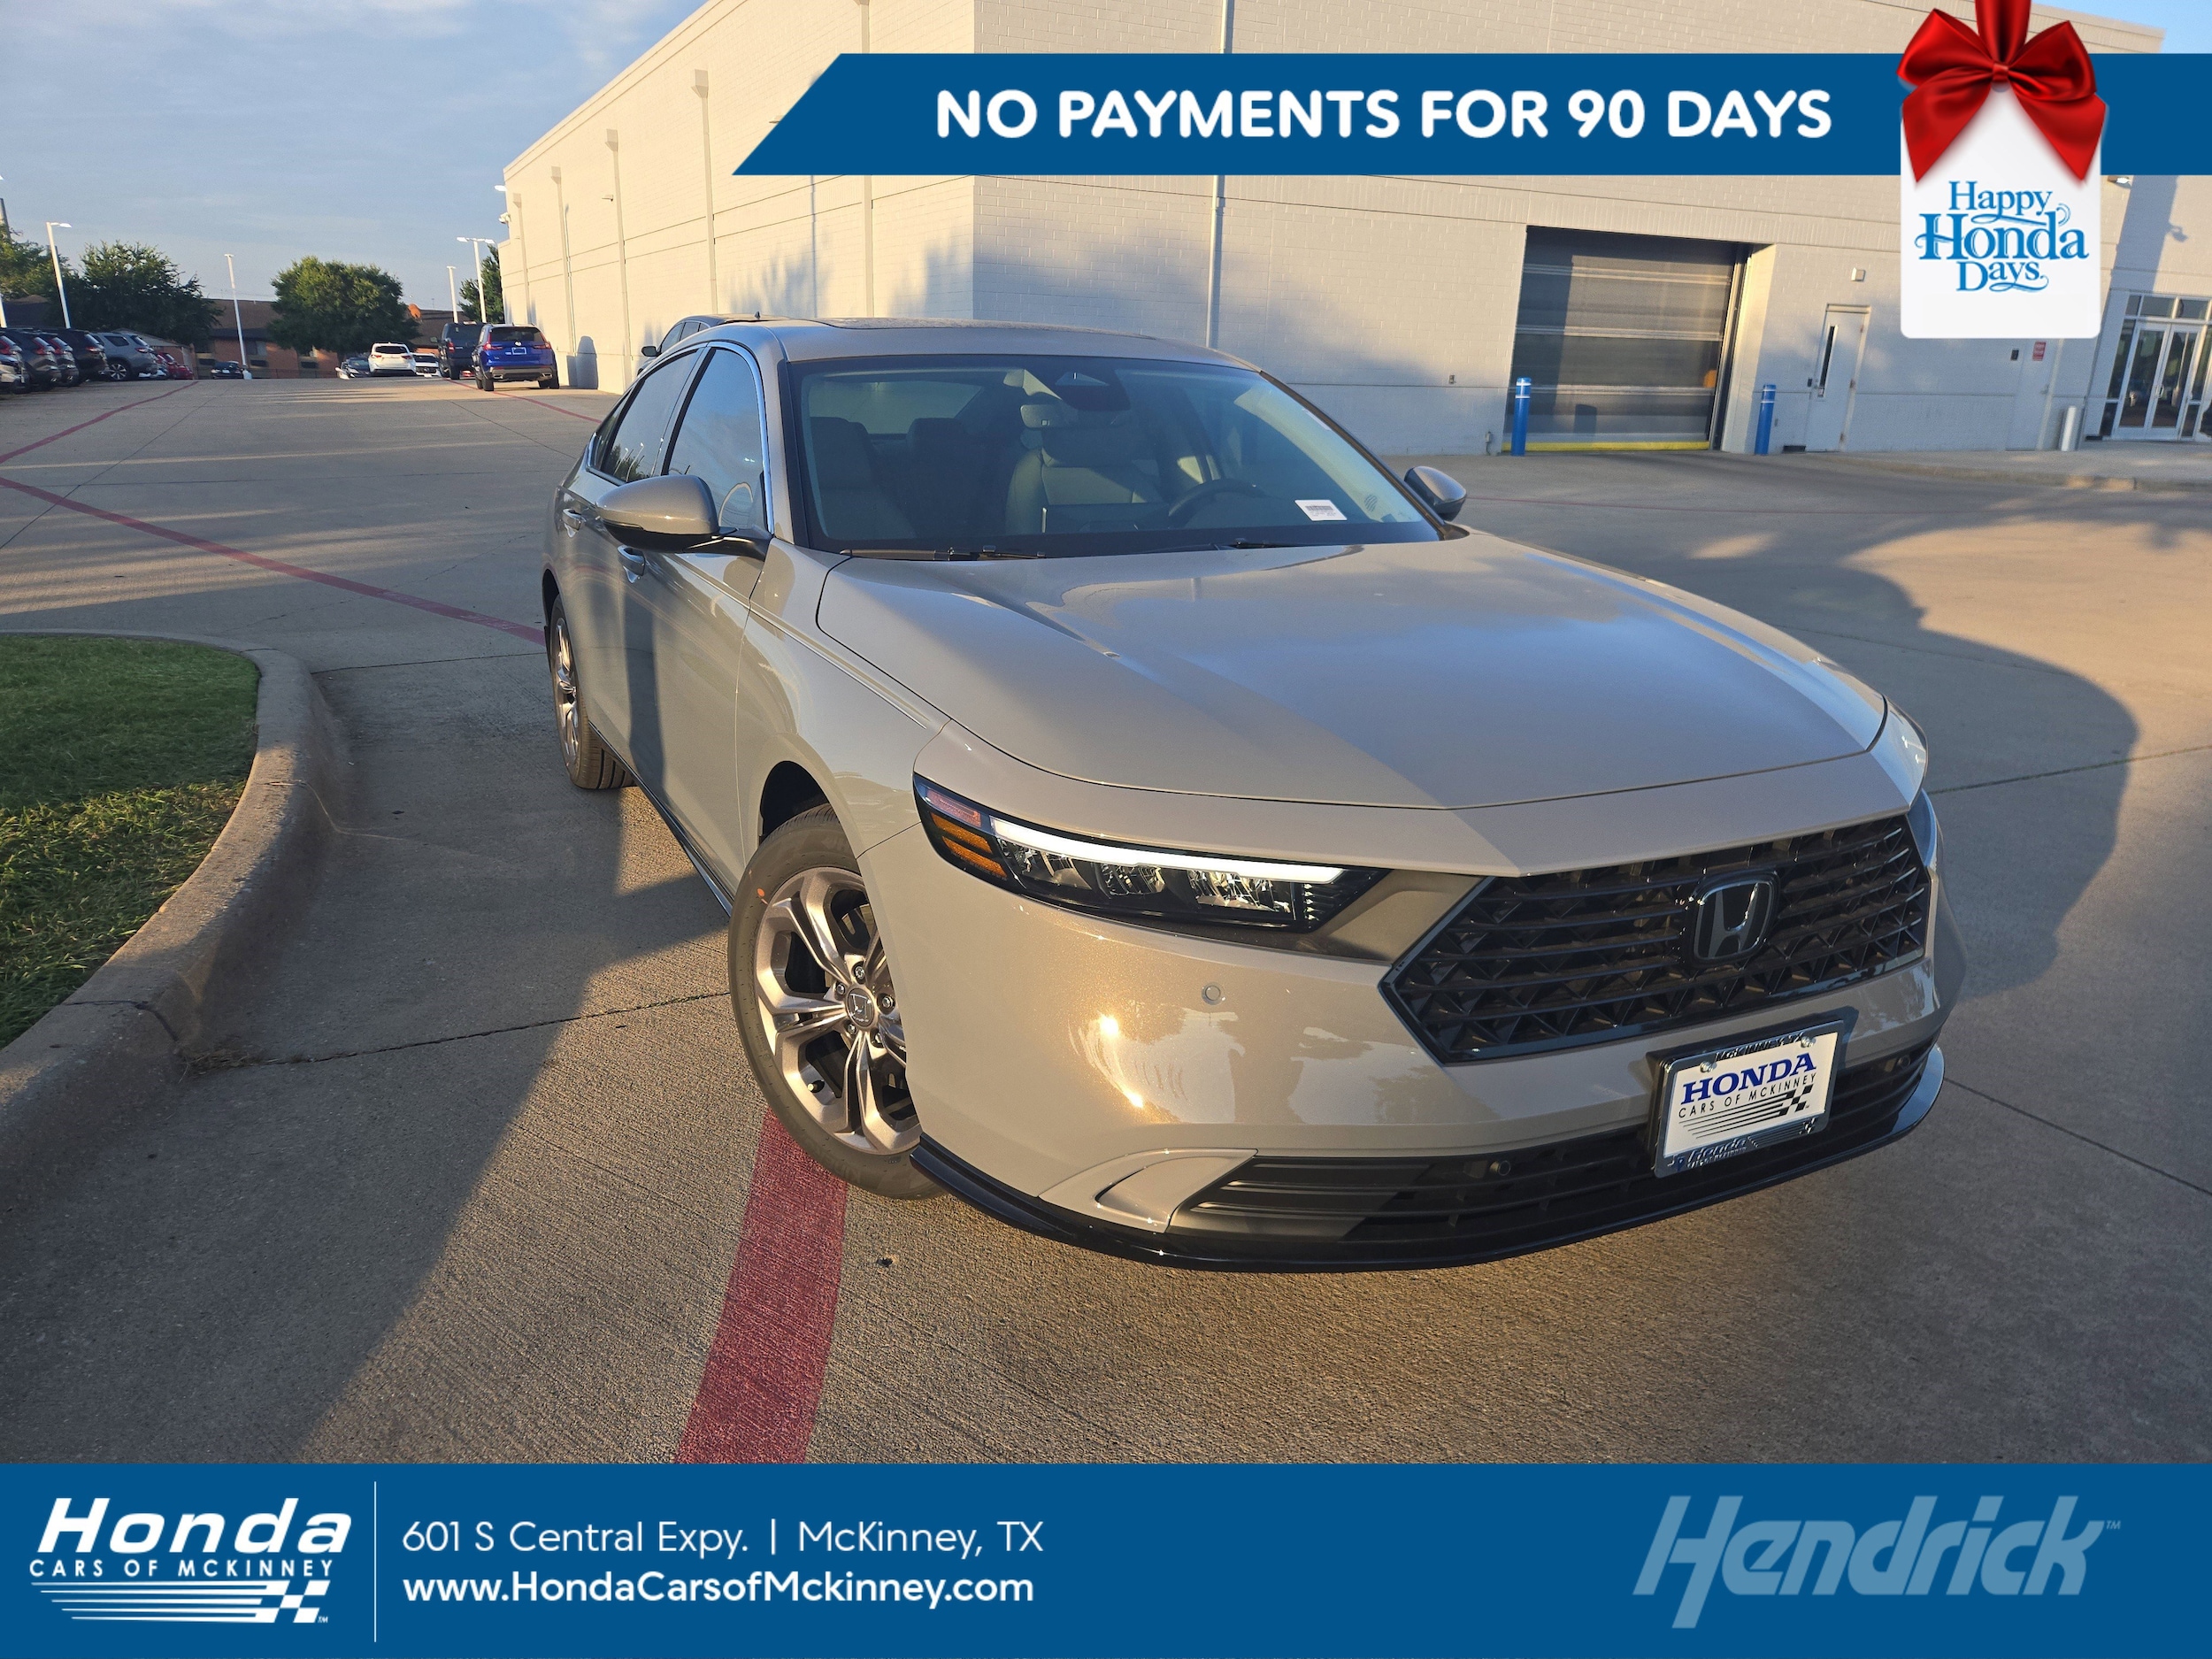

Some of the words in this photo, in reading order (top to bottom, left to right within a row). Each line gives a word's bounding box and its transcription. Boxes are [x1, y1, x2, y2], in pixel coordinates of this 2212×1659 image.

[1678, 1097, 1715, 1118] CARS
[1724, 1094, 1740, 1107] OF
[1748, 1072, 1816, 1100] MCKINNEY
[1681, 1052, 1816, 1105] HONDA
